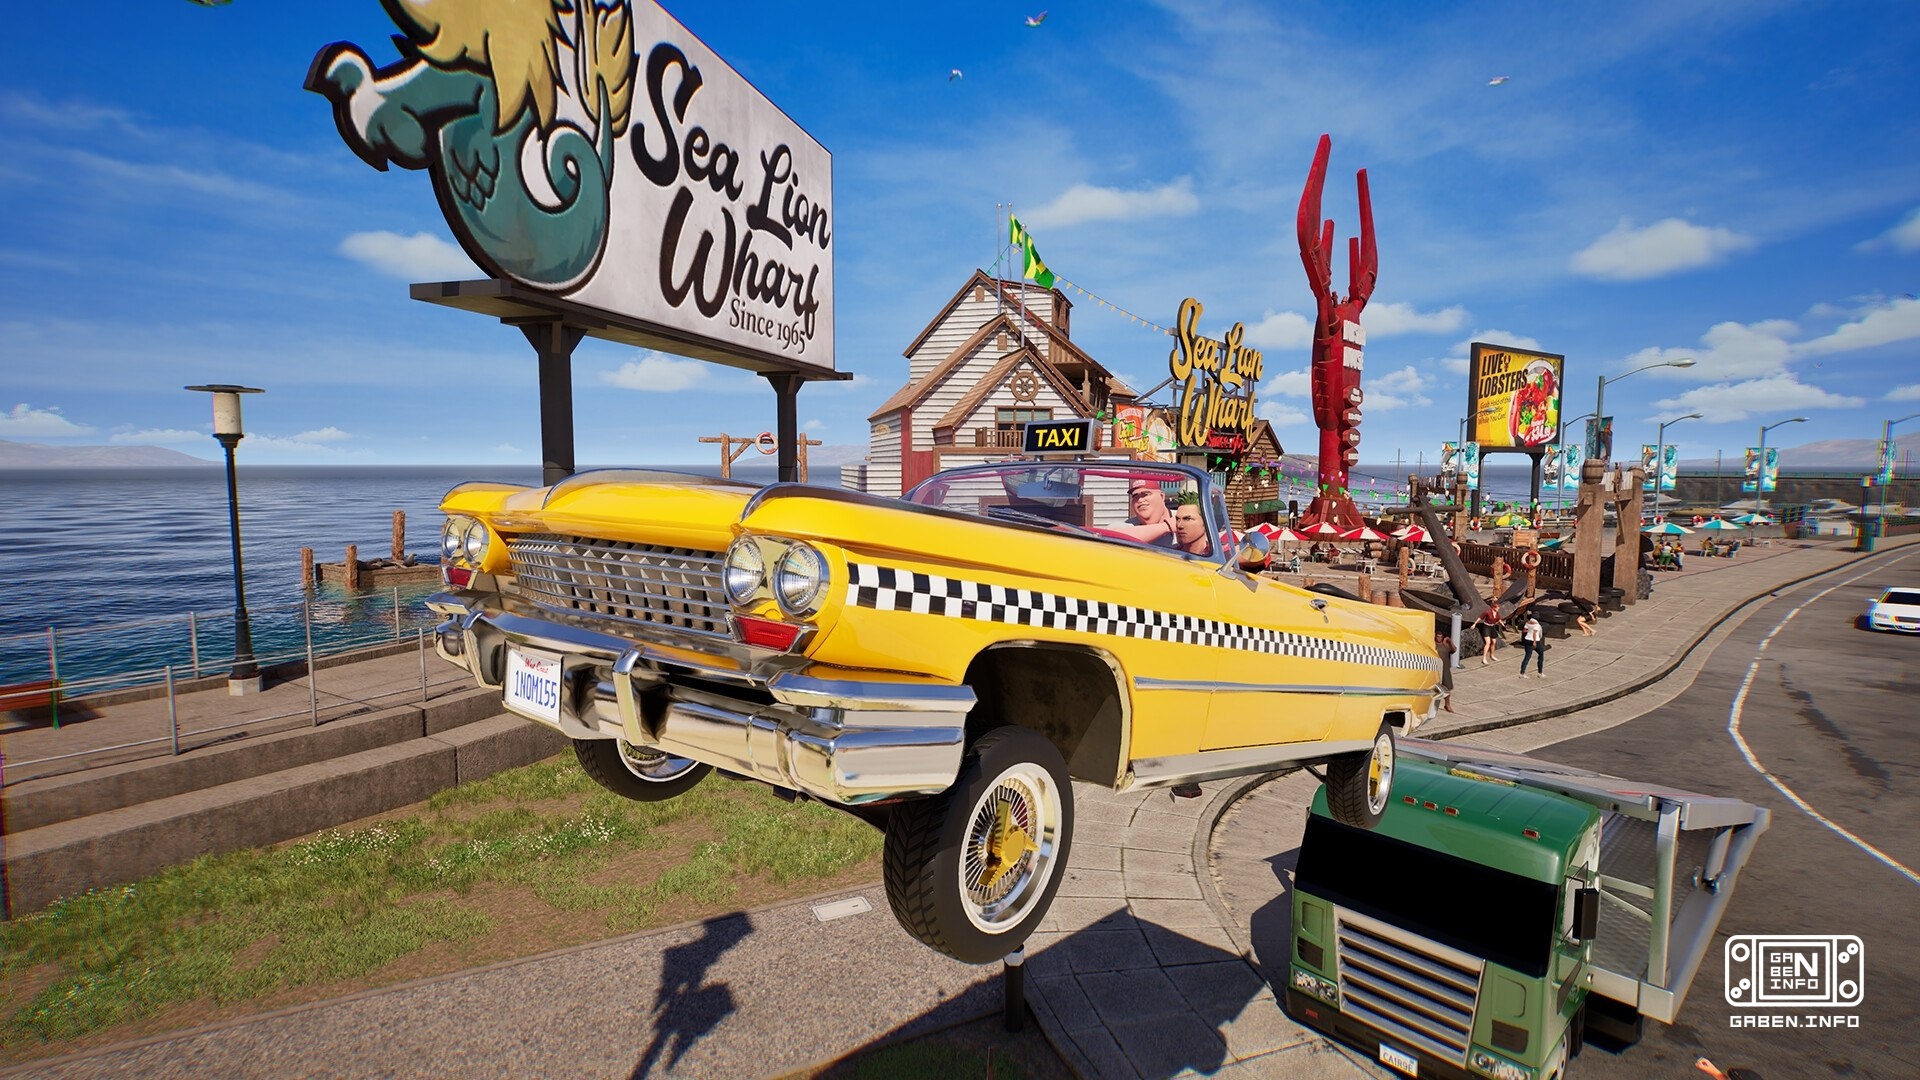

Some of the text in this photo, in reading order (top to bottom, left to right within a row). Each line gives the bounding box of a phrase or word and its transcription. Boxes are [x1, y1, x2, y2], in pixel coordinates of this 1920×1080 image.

[630, 42, 832, 251] Sea Lion
[659, 185, 821, 341] Wharf
[729, 298, 807, 355] Since 1965
[1170, 297, 1264, 389] Sea Lion
[1478, 368, 1529, 400] LOBSTERS
[1482, 353, 1504, 376] LIVE
[1035, 427, 1080, 447] TAXI
[1179, 374, 1257, 447] Wharf
